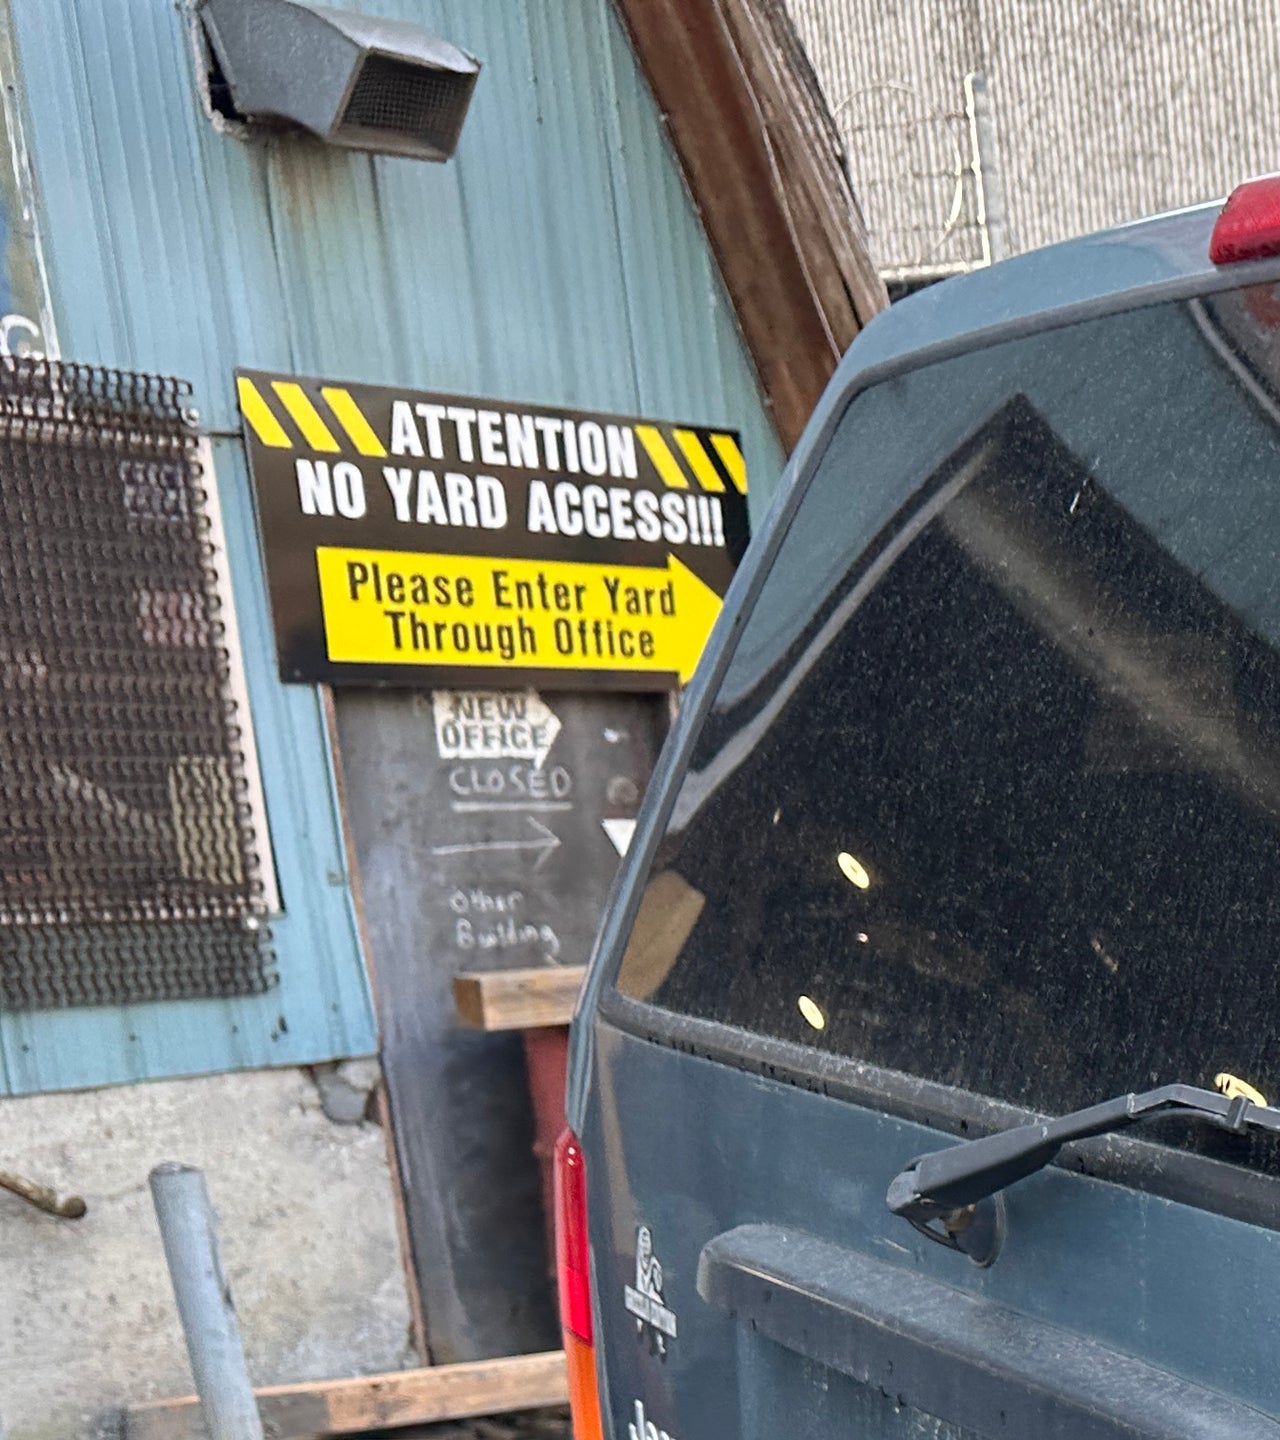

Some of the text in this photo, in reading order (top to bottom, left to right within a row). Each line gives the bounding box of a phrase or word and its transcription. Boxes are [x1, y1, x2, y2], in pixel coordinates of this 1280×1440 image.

[390, 400, 637, 480] ATTENTION
[296, 458, 726, 547] NO YARD ACCESS!!!
[346, 561, 677, 617] Please Enter Yard
[384, 610, 656, 661] Through Office
[449, 694, 526, 720] NEW
[442, 720, 551, 750] OFFICE
[449, 765, 572, 798] CLOSED
